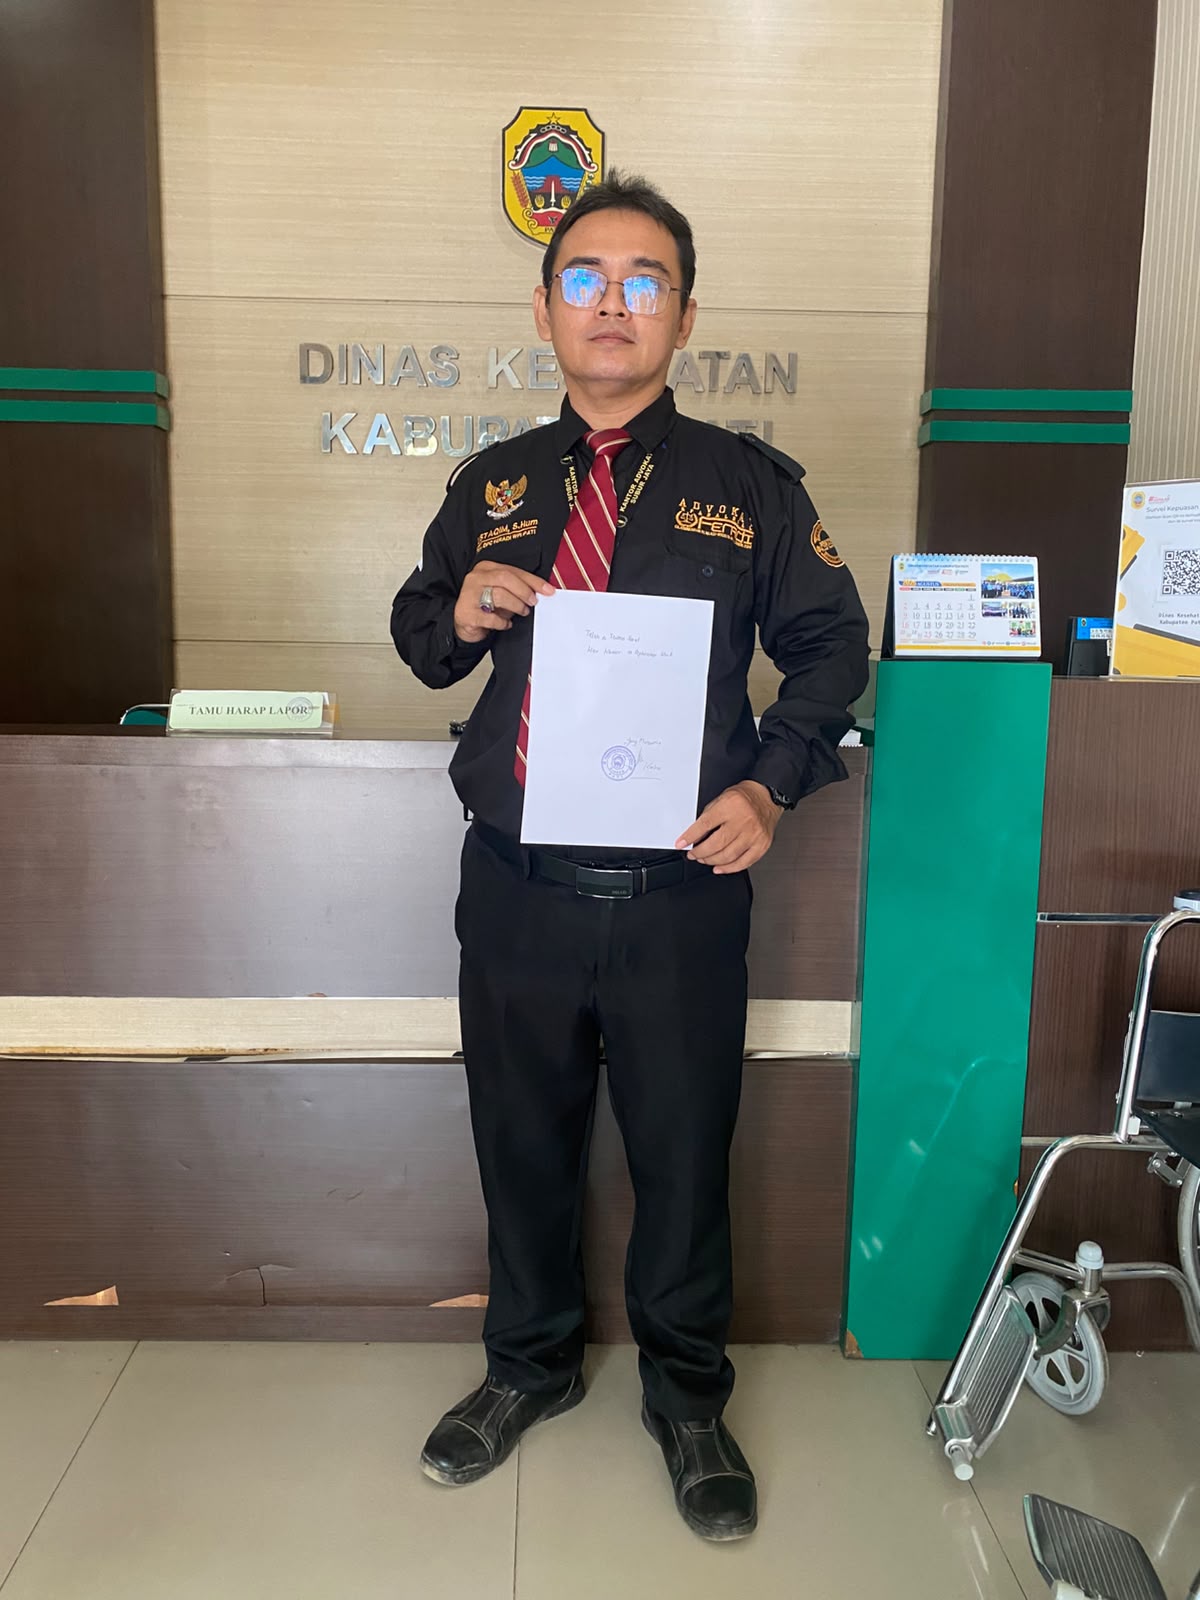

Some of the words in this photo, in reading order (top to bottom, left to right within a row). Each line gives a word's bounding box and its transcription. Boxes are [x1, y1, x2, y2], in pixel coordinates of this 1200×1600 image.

[300, 343, 460, 388] DINAS
[488, 347, 799, 394] KEATAN
[564, 477, 574, 502] SUBUR
[569, 466, 579, 495] KANTOR
[630, 481, 646, 504] SUBUR
[642, 464, 655, 481] JAYA
[619, 483, 637, 512] KANTOR
[512, 519, 538, 530] S.Hum
[189, 706, 223, 715] TAMU
[226, 706, 266, 715] HARAP
[269, 706, 309, 715] LAPOR
